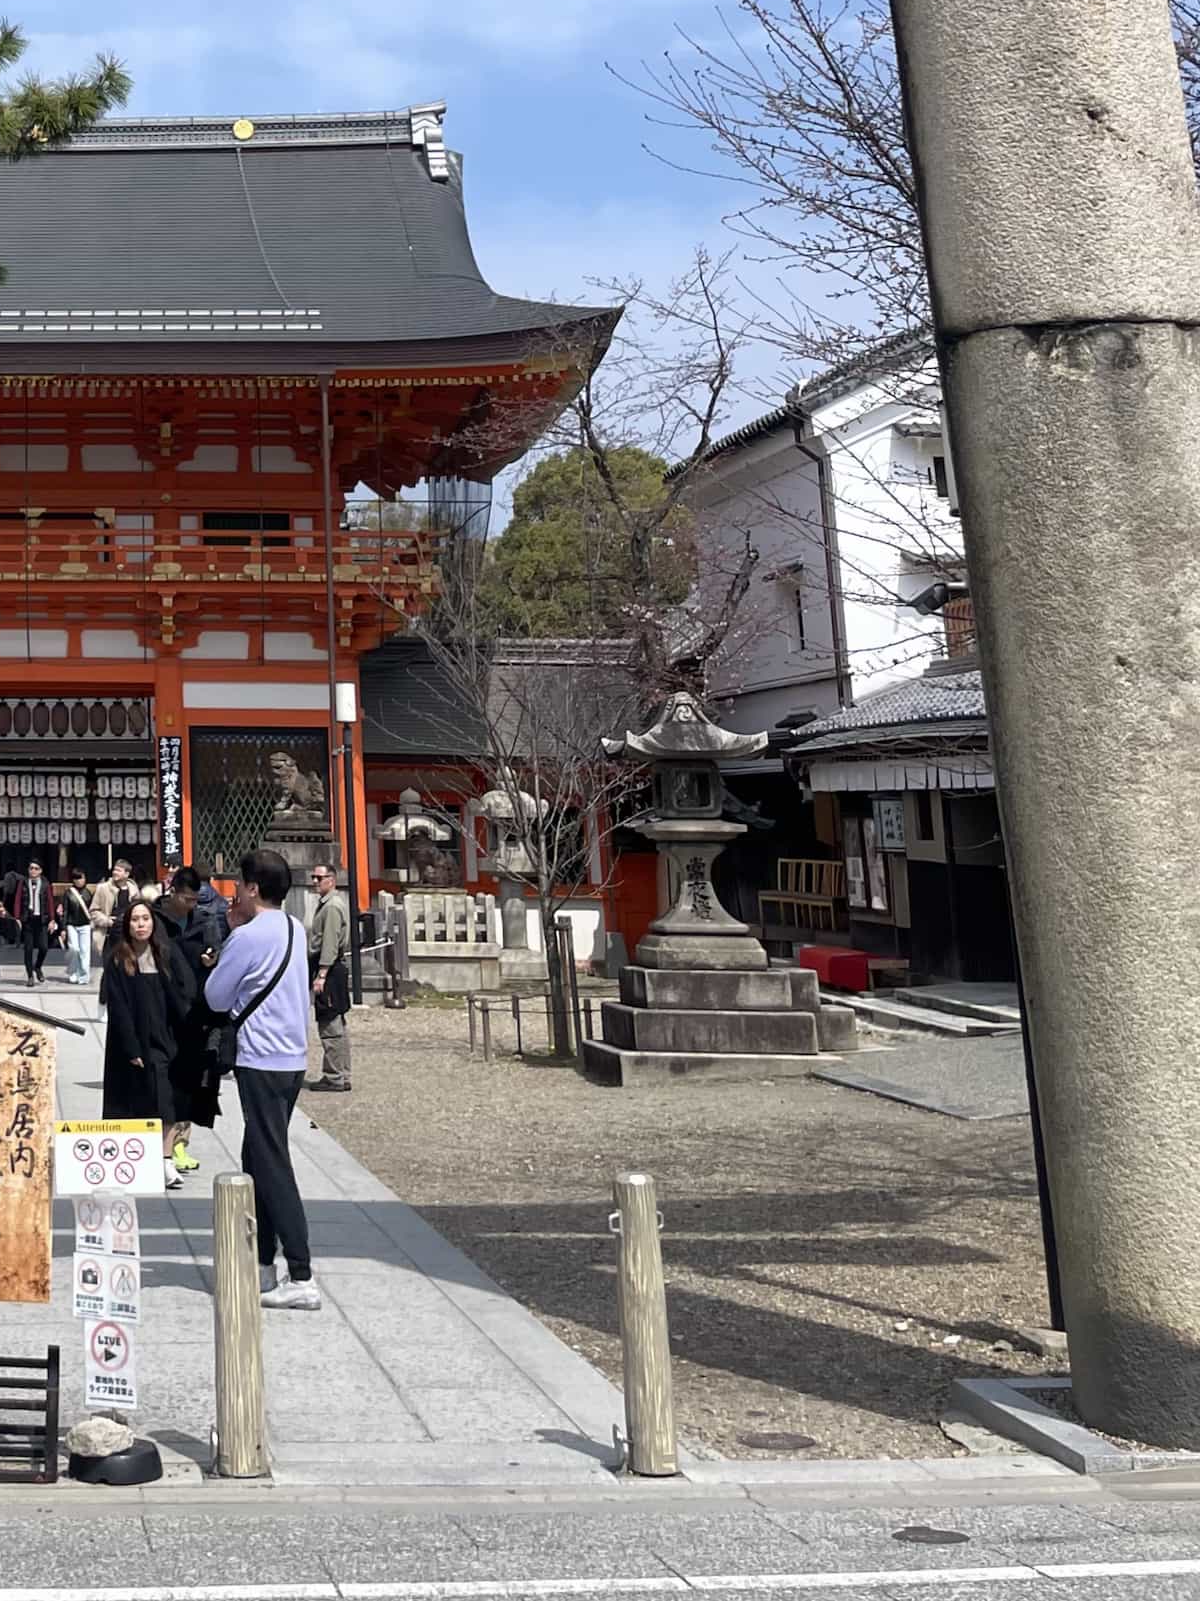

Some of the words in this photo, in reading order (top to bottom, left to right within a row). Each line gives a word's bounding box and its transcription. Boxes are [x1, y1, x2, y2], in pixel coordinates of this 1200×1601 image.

[8, 1029, 41, 1179] 石鳥居内
[75, 1121, 122, 1133] Attention
[97, 1335, 122, 1347] LIVE
